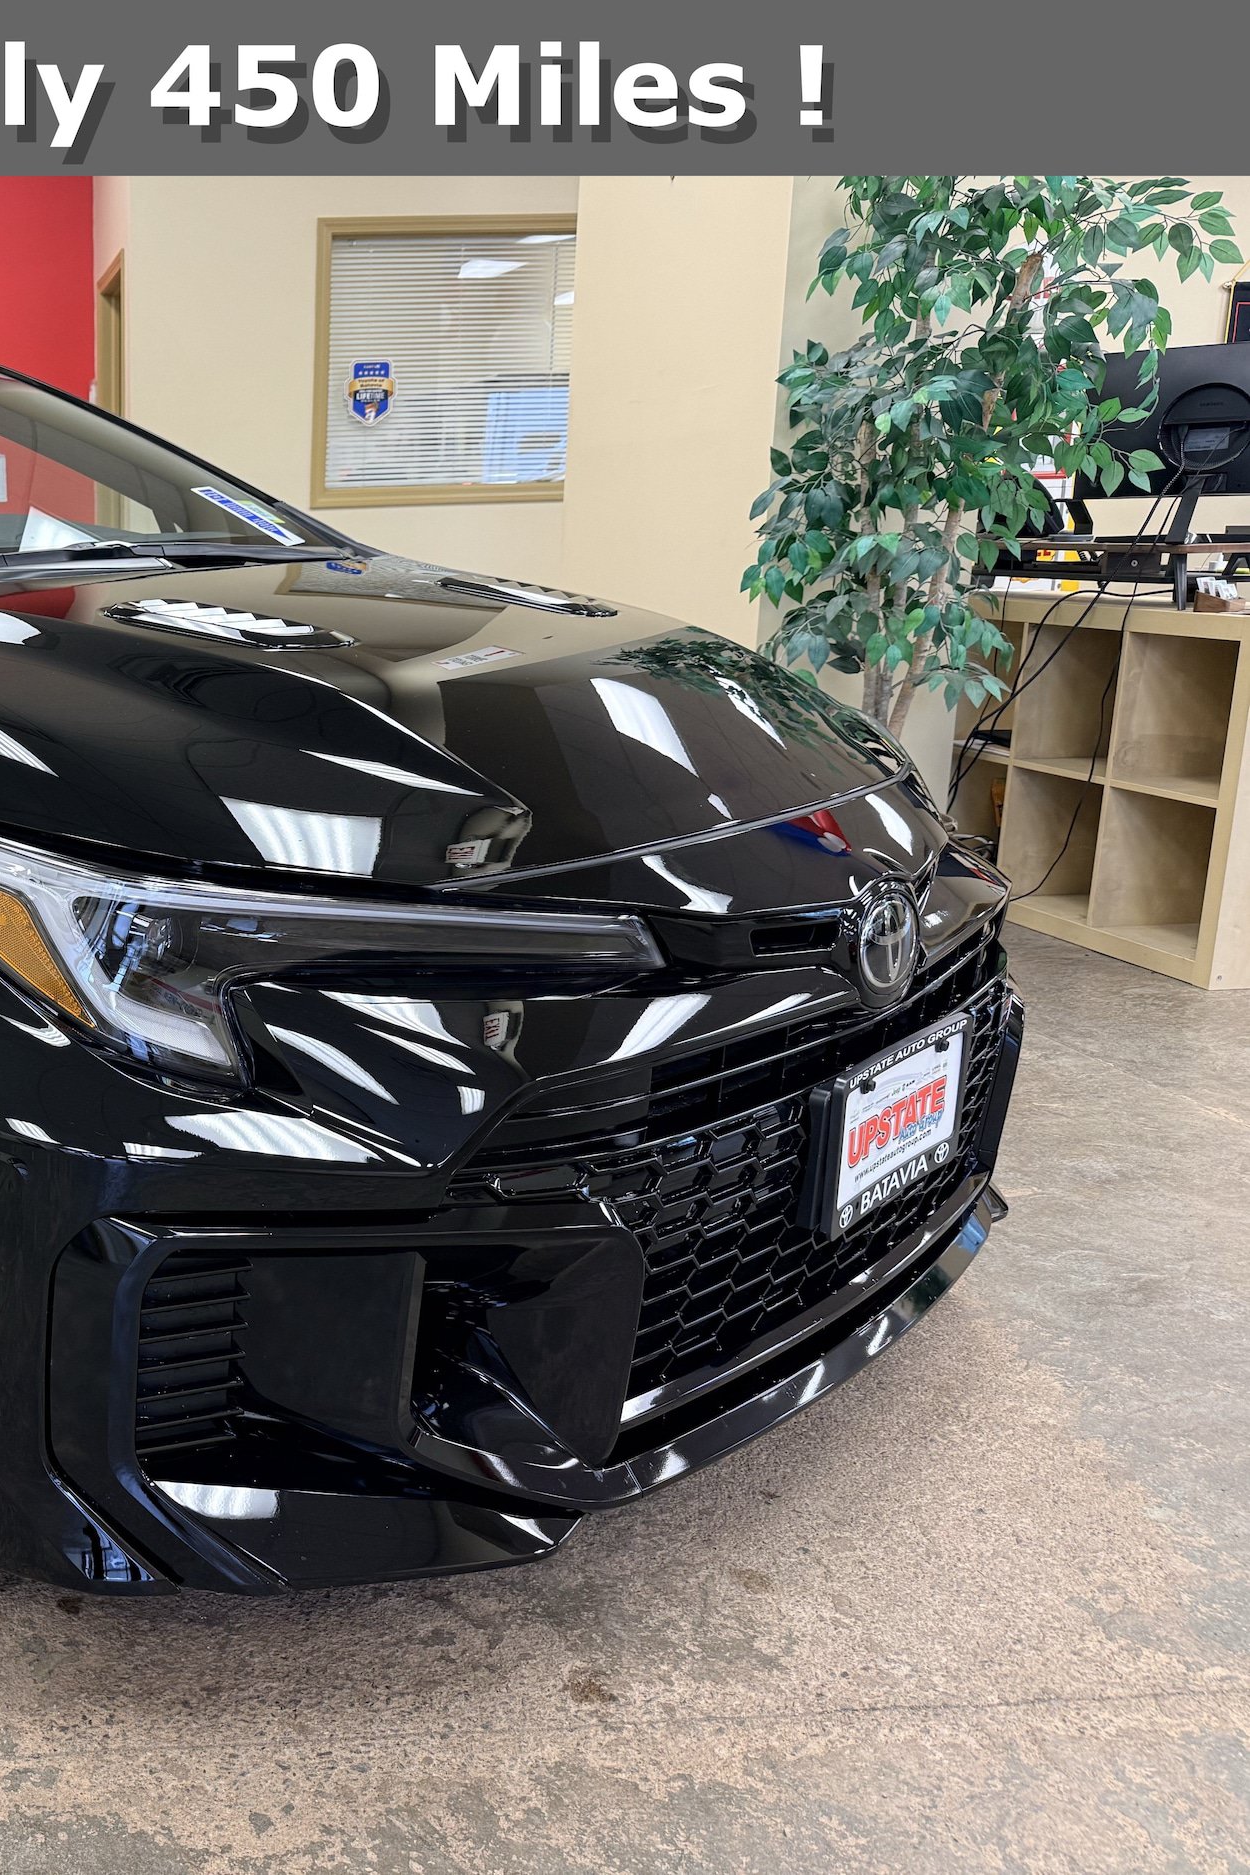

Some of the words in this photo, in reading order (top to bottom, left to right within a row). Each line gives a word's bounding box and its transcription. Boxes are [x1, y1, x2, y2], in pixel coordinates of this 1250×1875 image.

[849, 1054, 895, 1089] UPSTATE
[895, 1038, 926, 1062] AUTO
[927, 1018, 968, 1044] GROUP
[847, 1075, 948, 1169] UPSTATE
[854, 1129, 932, 1183] www.upstateautogroup.com
[860, 1154, 929, 1216] BATAVIA
